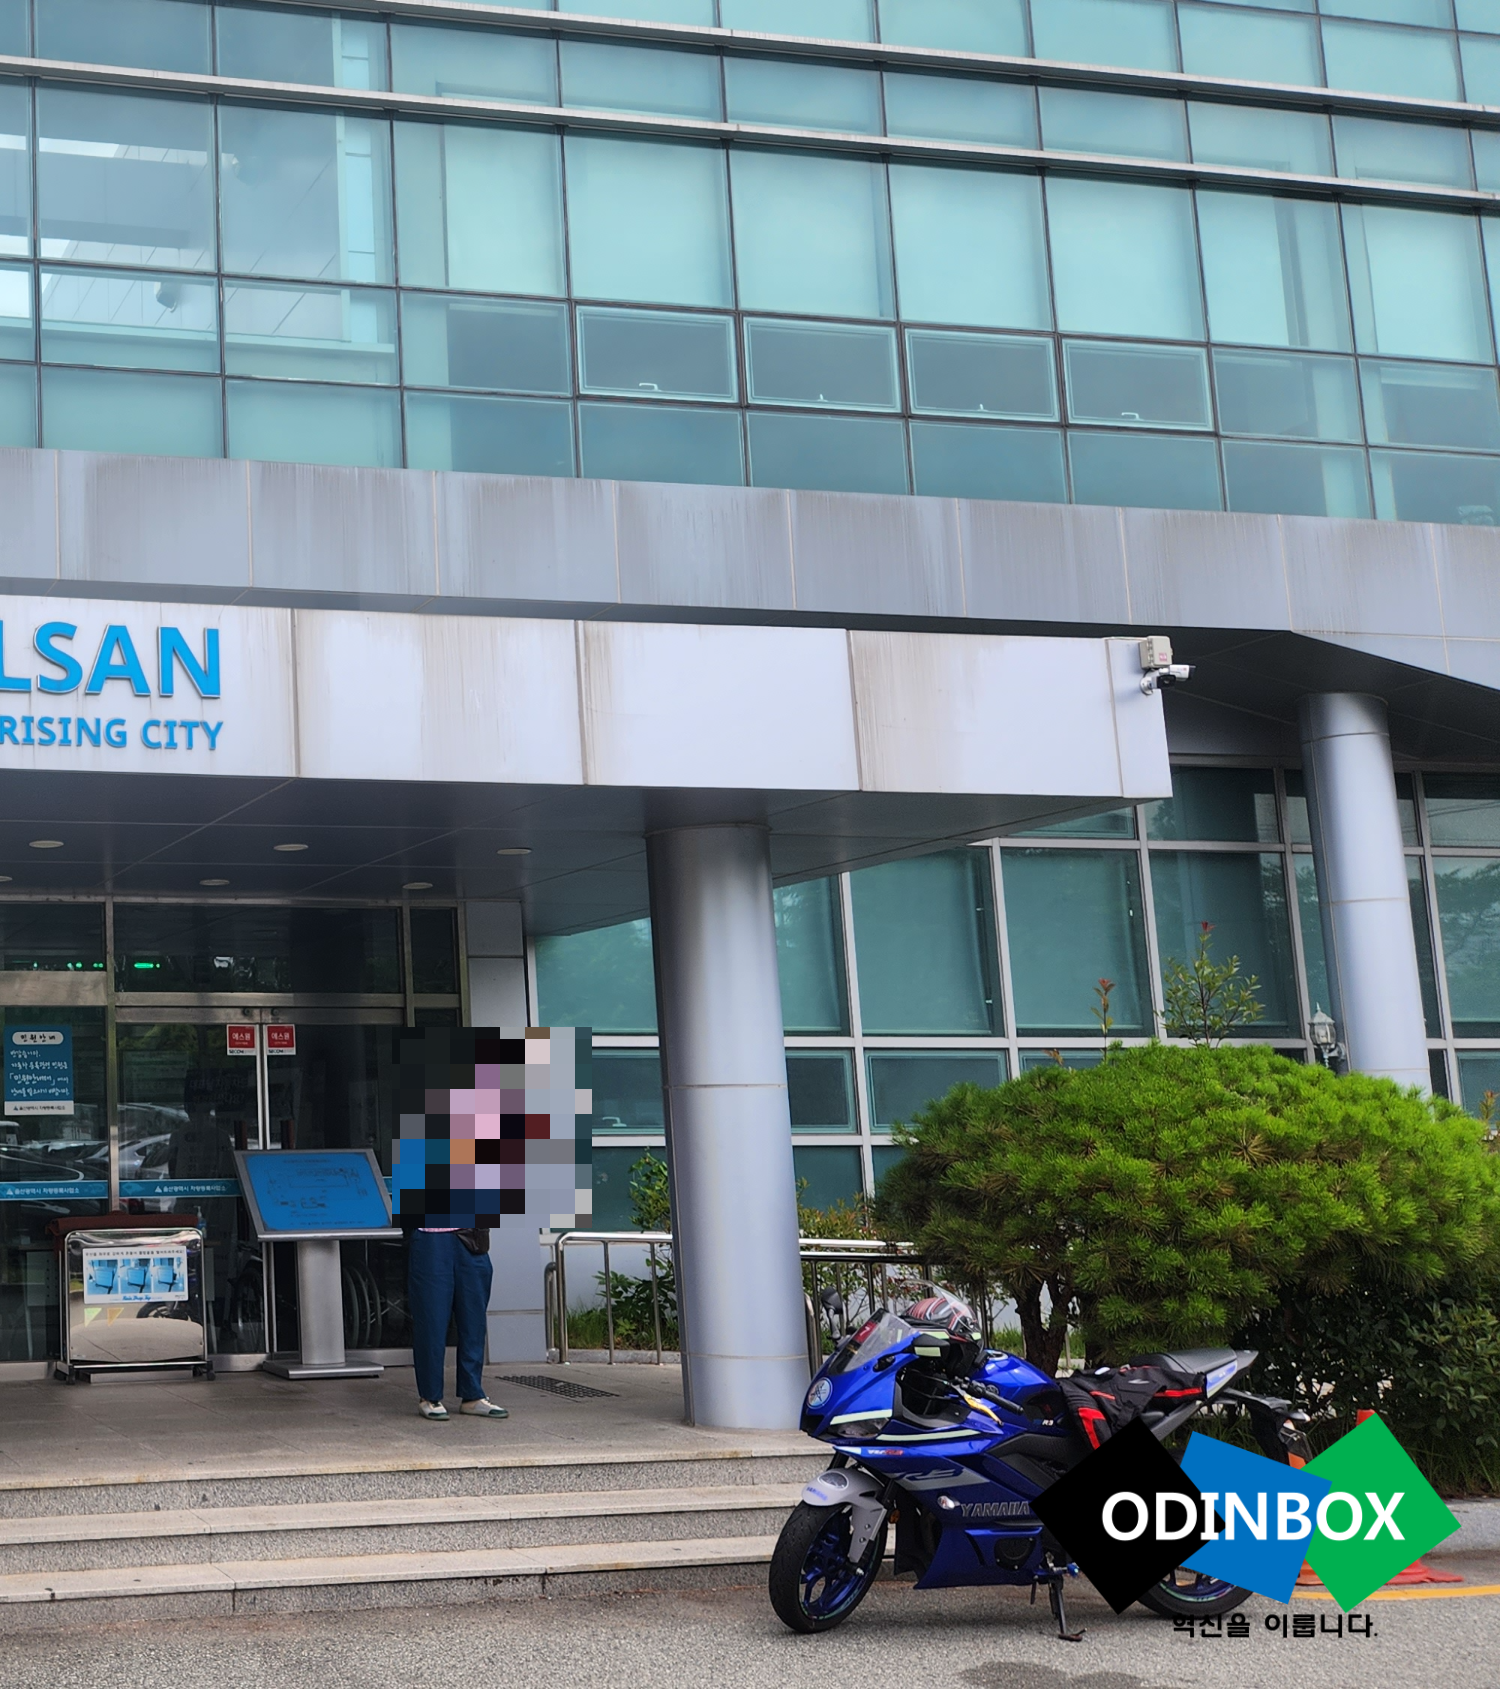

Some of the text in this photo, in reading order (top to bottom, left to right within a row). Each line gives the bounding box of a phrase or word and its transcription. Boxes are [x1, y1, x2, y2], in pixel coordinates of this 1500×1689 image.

[141, 718, 224, 750] CITY
[231, 1032, 251, 1041] 에스원
[271, 1032, 290, 1040] 에스원
[961, 1501, 1030, 1517] YAMAHA
